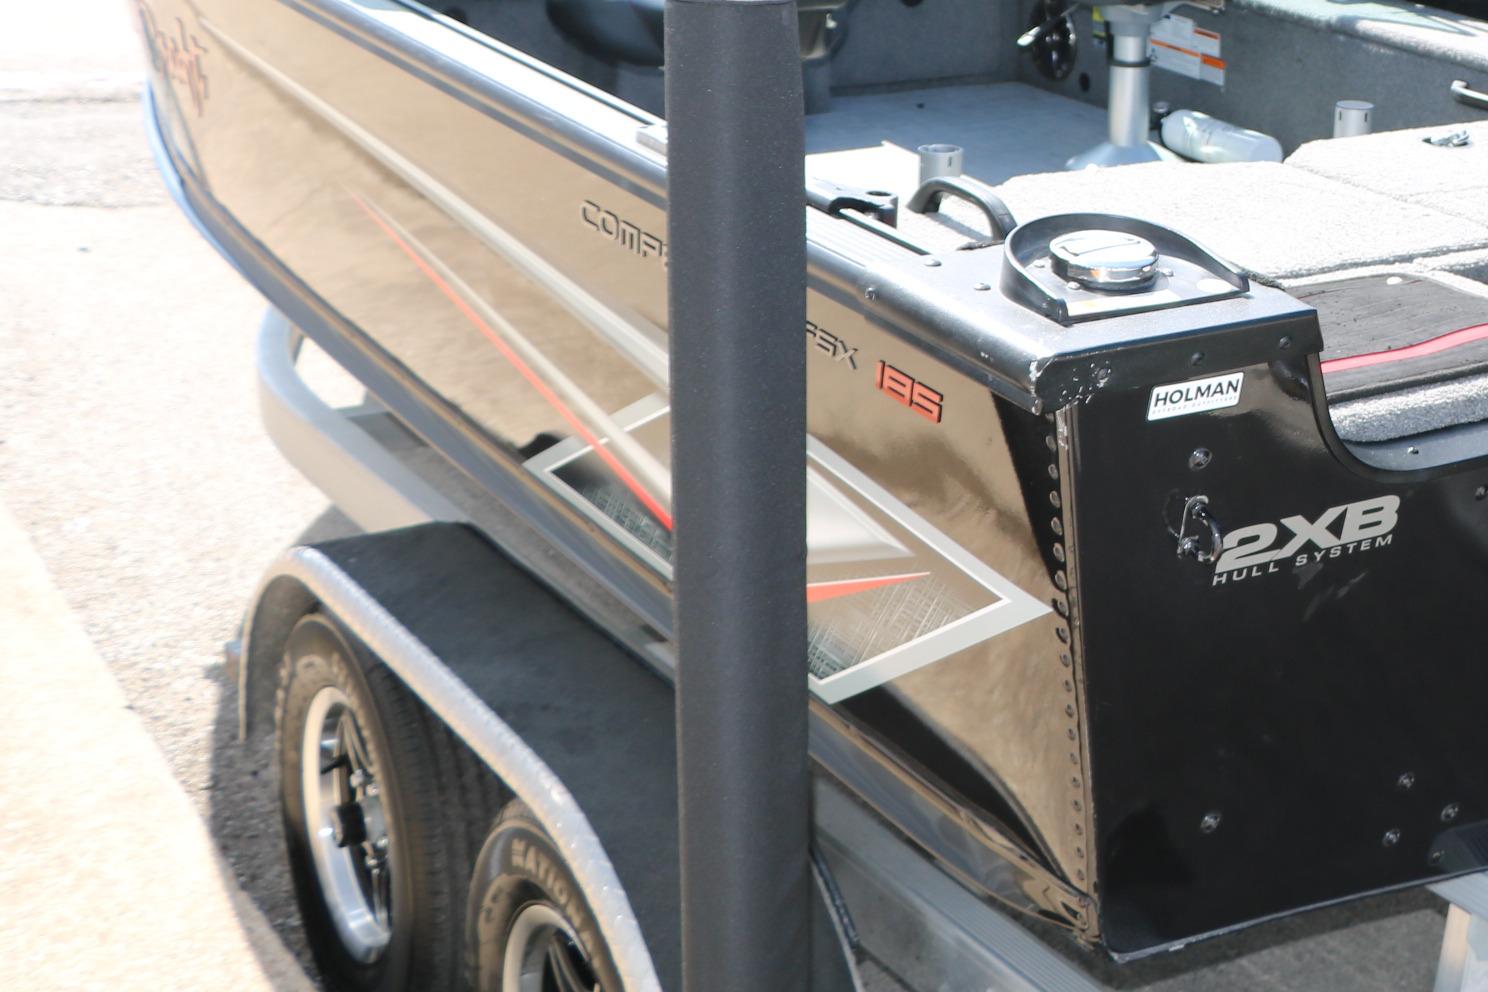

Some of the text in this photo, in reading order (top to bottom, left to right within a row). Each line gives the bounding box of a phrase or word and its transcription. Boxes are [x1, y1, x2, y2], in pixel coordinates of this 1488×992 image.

[875, 359, 944, 424] 185
[1153, 378, 1240, 408] HOLMAN
[1212, 534, 1394, 587] HULL SYSTEM
[1214, 494, 1401, 574] 2XB
